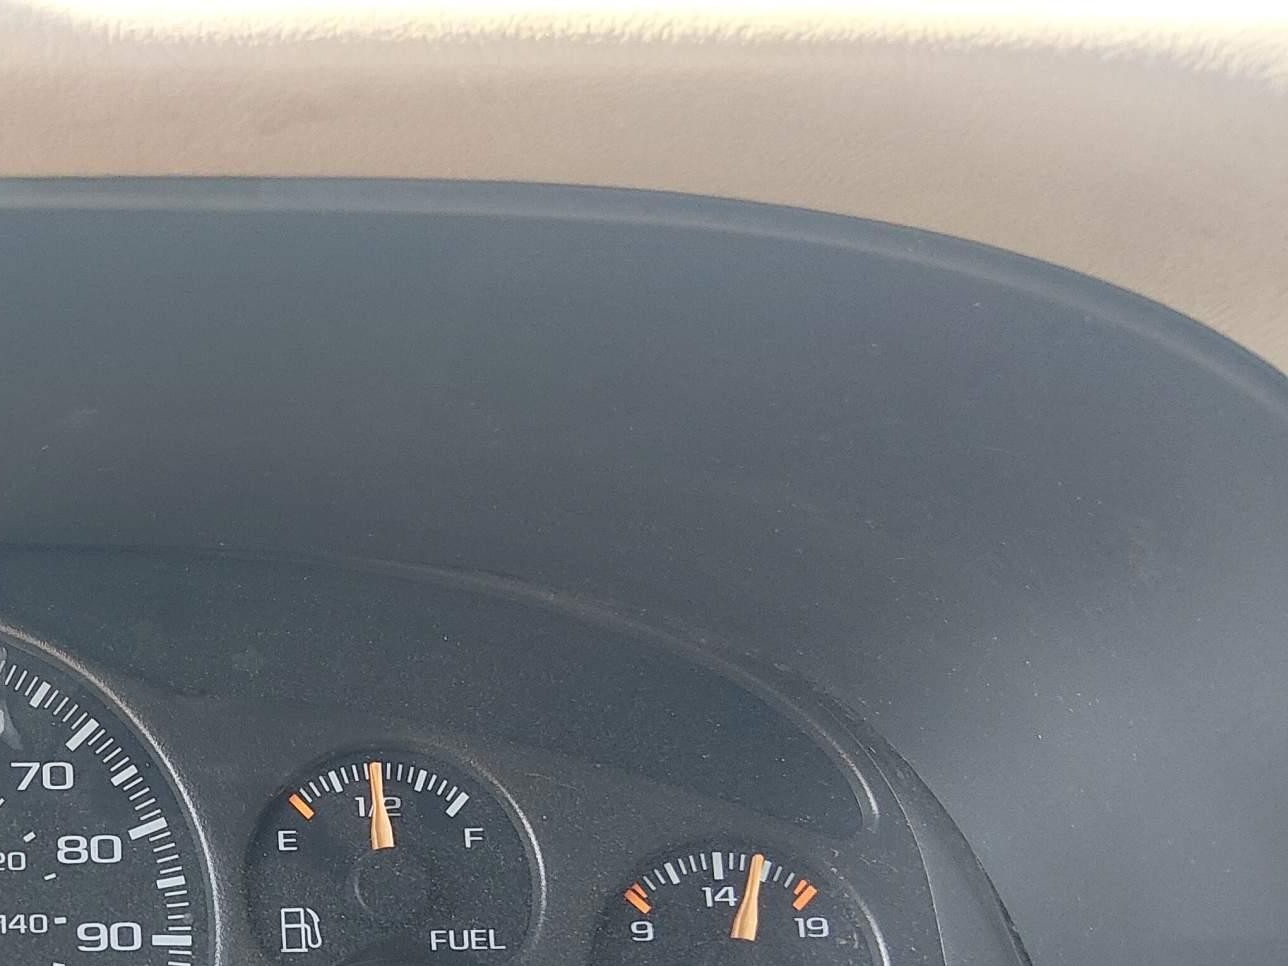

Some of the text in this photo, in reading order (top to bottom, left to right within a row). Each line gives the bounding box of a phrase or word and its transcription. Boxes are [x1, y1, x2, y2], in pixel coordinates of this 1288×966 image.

[11, 762, 73, 790] 70
[354, 796, 402, 817] 12
[278, 831, 297, 850] E
[465, 828, 483, 847] F
[57, 835, 121, 863] 80
[702, 887, 737, 907] 14
[77, 922, 141, 951] 90
[631, 922, 653, 941] 9
[795, 918, 829, 937] 19
[431, 930, 506, 950] FUEL
